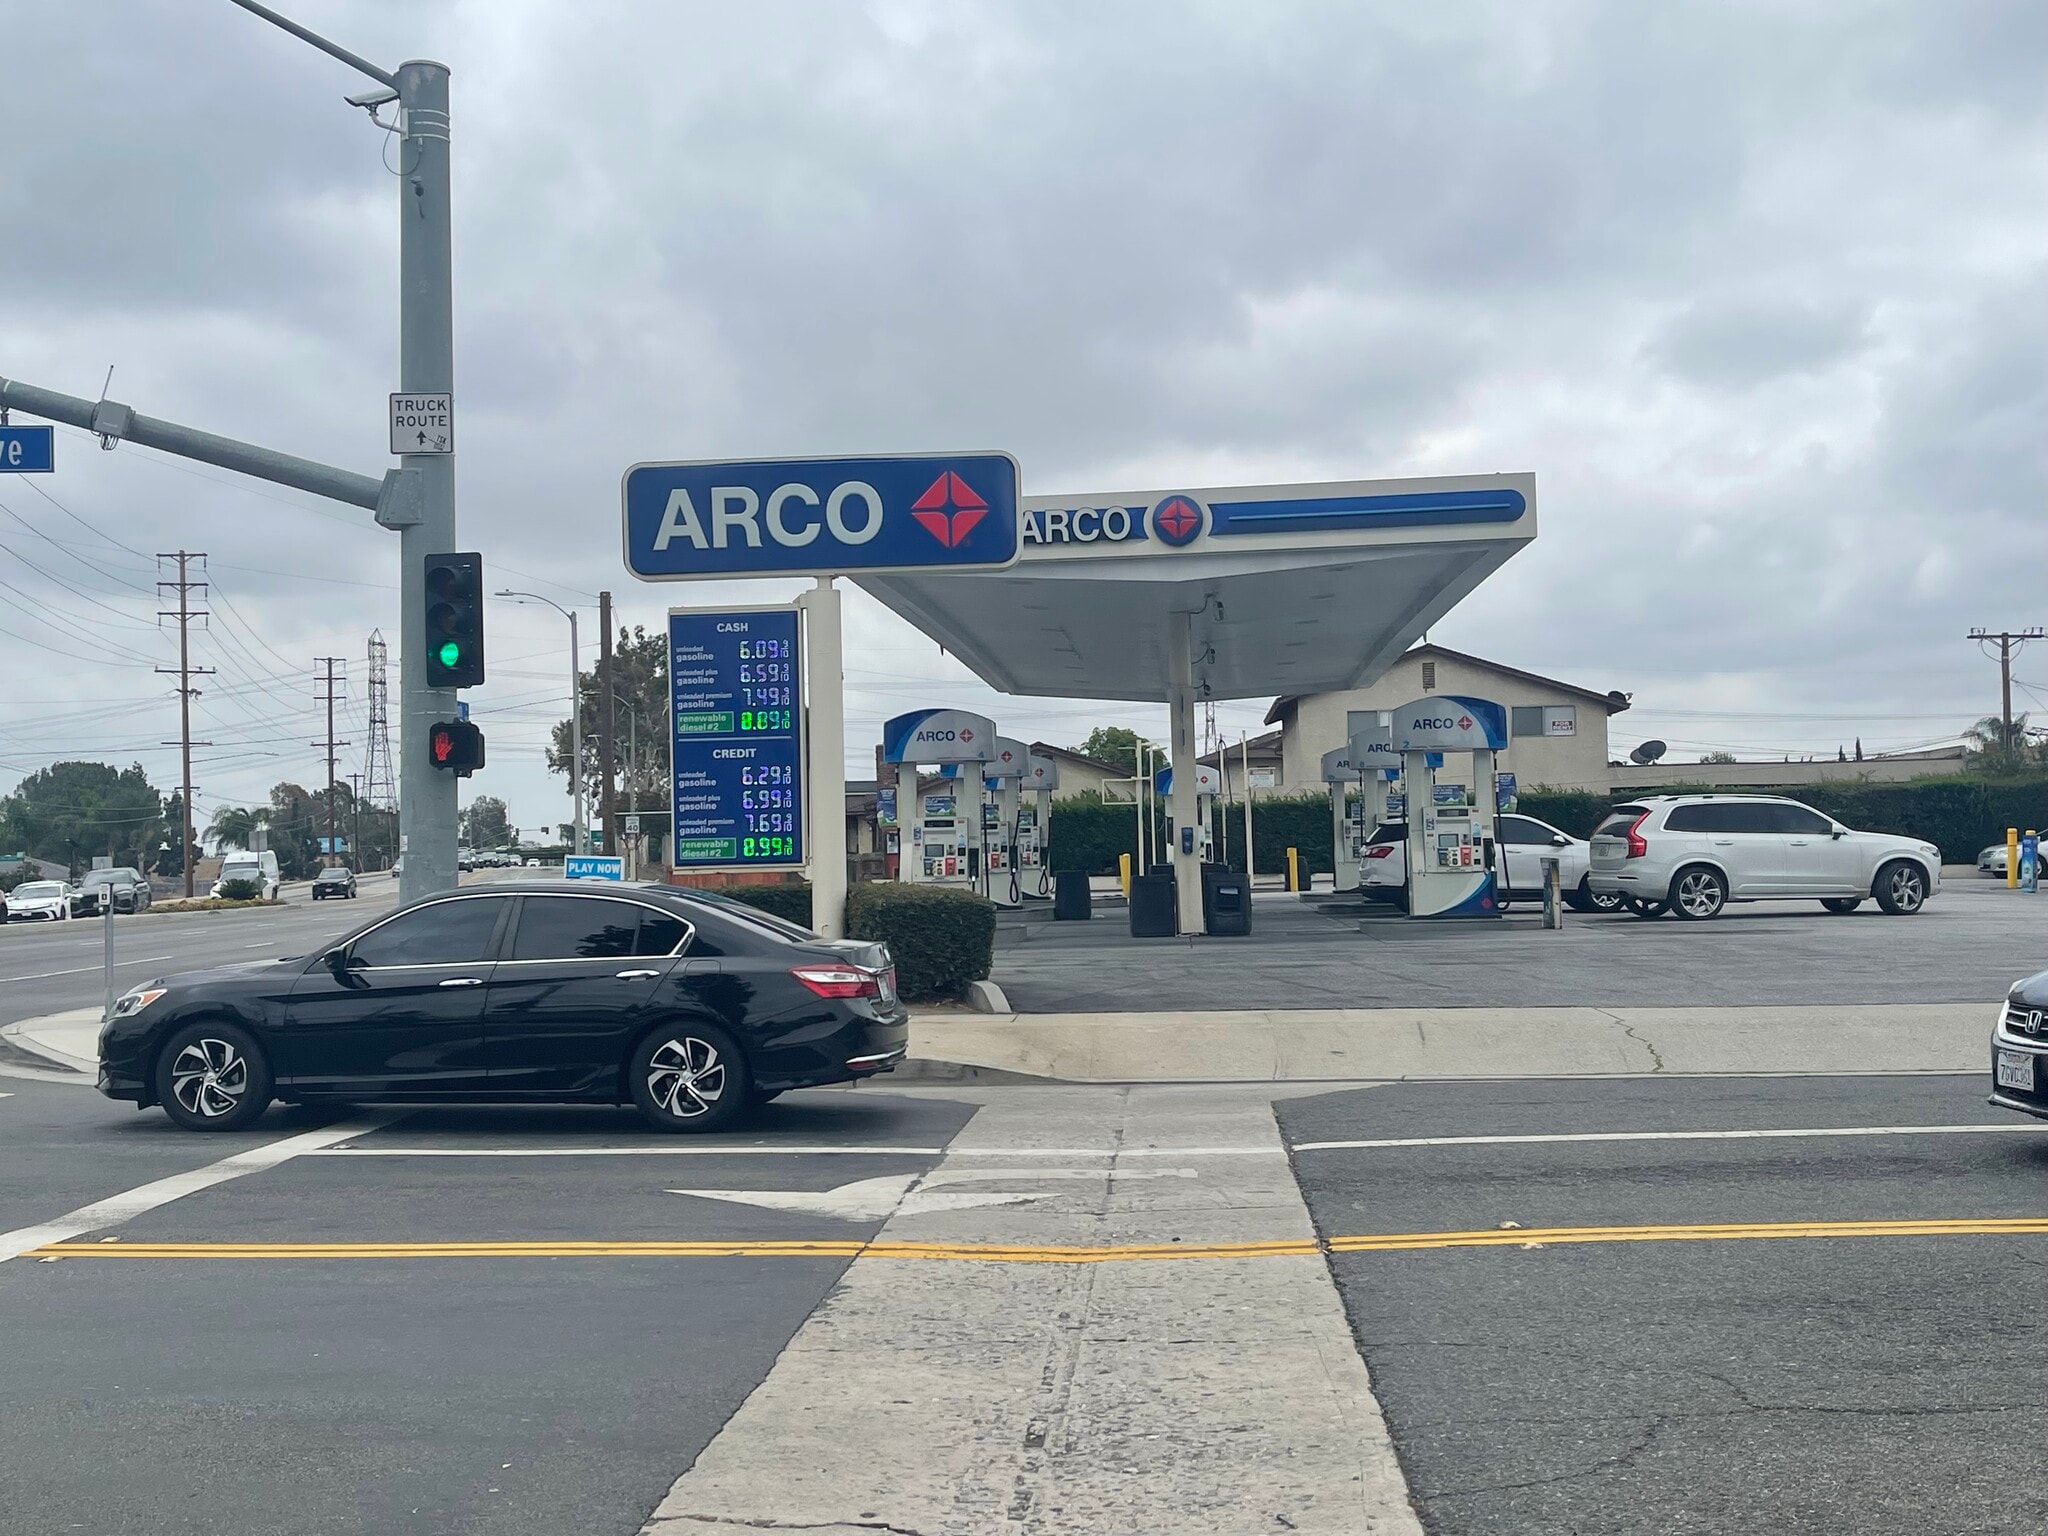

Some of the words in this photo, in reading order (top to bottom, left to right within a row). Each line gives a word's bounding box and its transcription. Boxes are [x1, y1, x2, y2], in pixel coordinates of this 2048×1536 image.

[395, 400, 447, 411] TRUCK
[396, 415, 447, 427] ROUTE
[652, 480, 884, 551] ARCO
[1023, 505, 1131, 544] ARCO
[716, 622, 749, 633] CASH
[740, 639, 778, 659] 6.09
[676, 652, 714, 663] gasoline
[740, 663, 779, 683] 6.59
[676, 676, 715, 687] gasoline
[742, 687, 780, 706] 7.49
[677, 700, 715, 710] gasoline
[679, 714, 727, 723] renewable
[1413, 718, 1454, 730] ARCO
[680, 723, 706, 732] diesel
[707, 722, 719, 731] #2
[916, 730, 956, 742] ARCO
[1367, 743, 1391, 753] ARC
[1403, 741, 1410, 749] 2
[712, 748, 757, 759] CREDIT
[742, 766, 781, 785] 6.29
[678, 778, 717, 789] gasoline
[742, 789, 781, 809] 6.99
[679, 802, 717, 812] gasoline
[627, 824, 639, 832] 40
[744, 813, 782, 832] 7.69
[679, 826, 717, 836] gasoline
[682, 839, 729, 848] renewable
[682, 849, 708, 857] diesel
[709, 849, 722, 857] #2
[568, 862, 594, 873] PLAY
[597, 863, 621, 874] NOW
